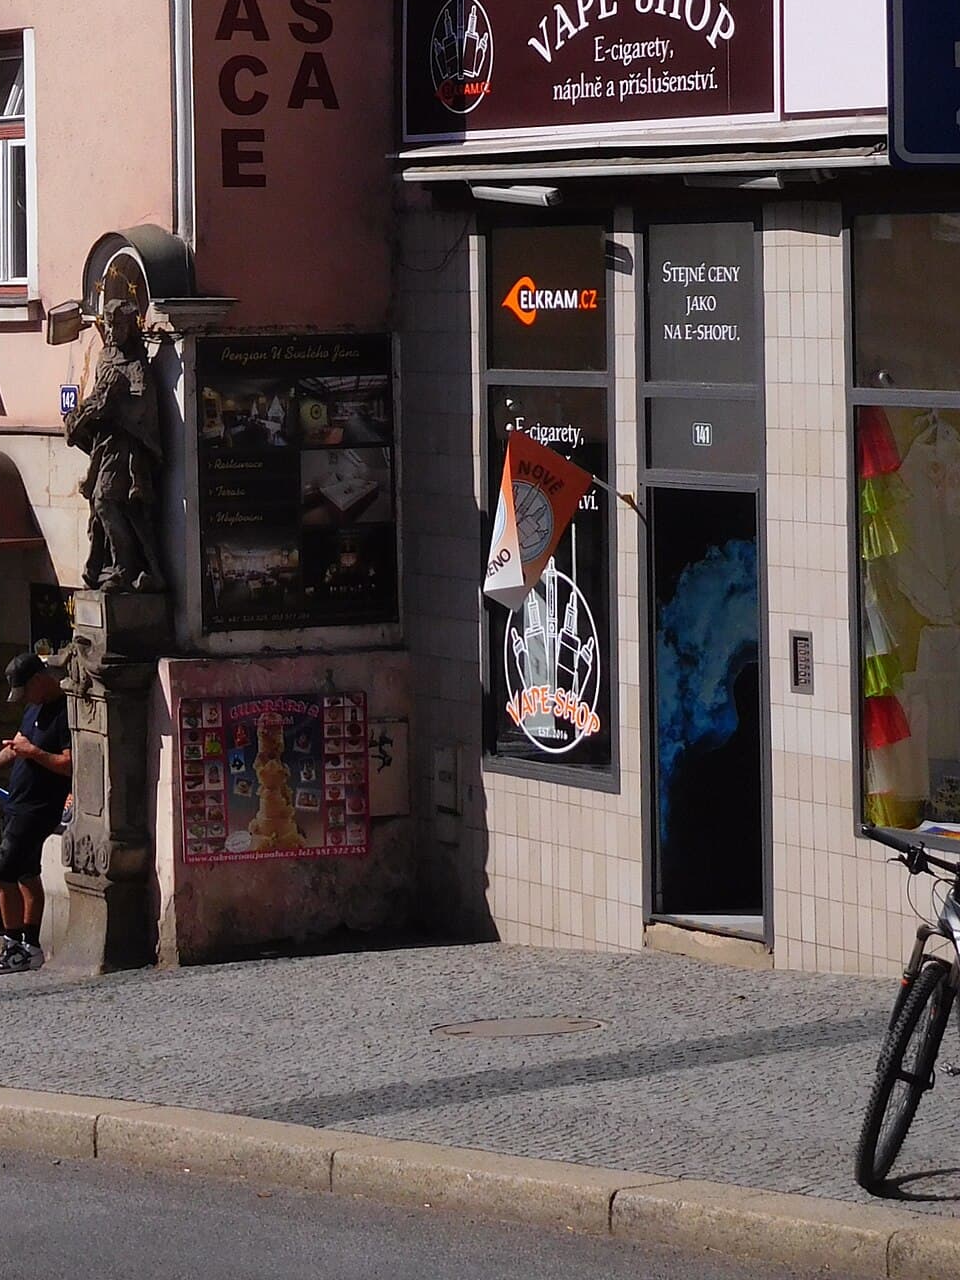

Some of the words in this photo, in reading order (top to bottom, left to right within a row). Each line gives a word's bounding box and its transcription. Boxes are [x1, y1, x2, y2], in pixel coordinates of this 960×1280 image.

[593, 35, 674, 66] E-cigarety,
[552, 72, 602, 105] náplně
[605, 83, 615, 98] a
[618, 67, 719, 102] příslušenství.
[708, 266, 741, 283] CENY
[520, 289, 598, 309] ELKRAM.CZ
[686, 295, 717, 316] JAKO
[663, 324, 682, 340] NA
[684, 323, 741, 341] E-SHOPU.
[62, 391, 76, 408] 142
[695, 425, 710, 443] 141
[506, 684, 552, 728] VAPE
[554, 688, 601, 737] SHOP
